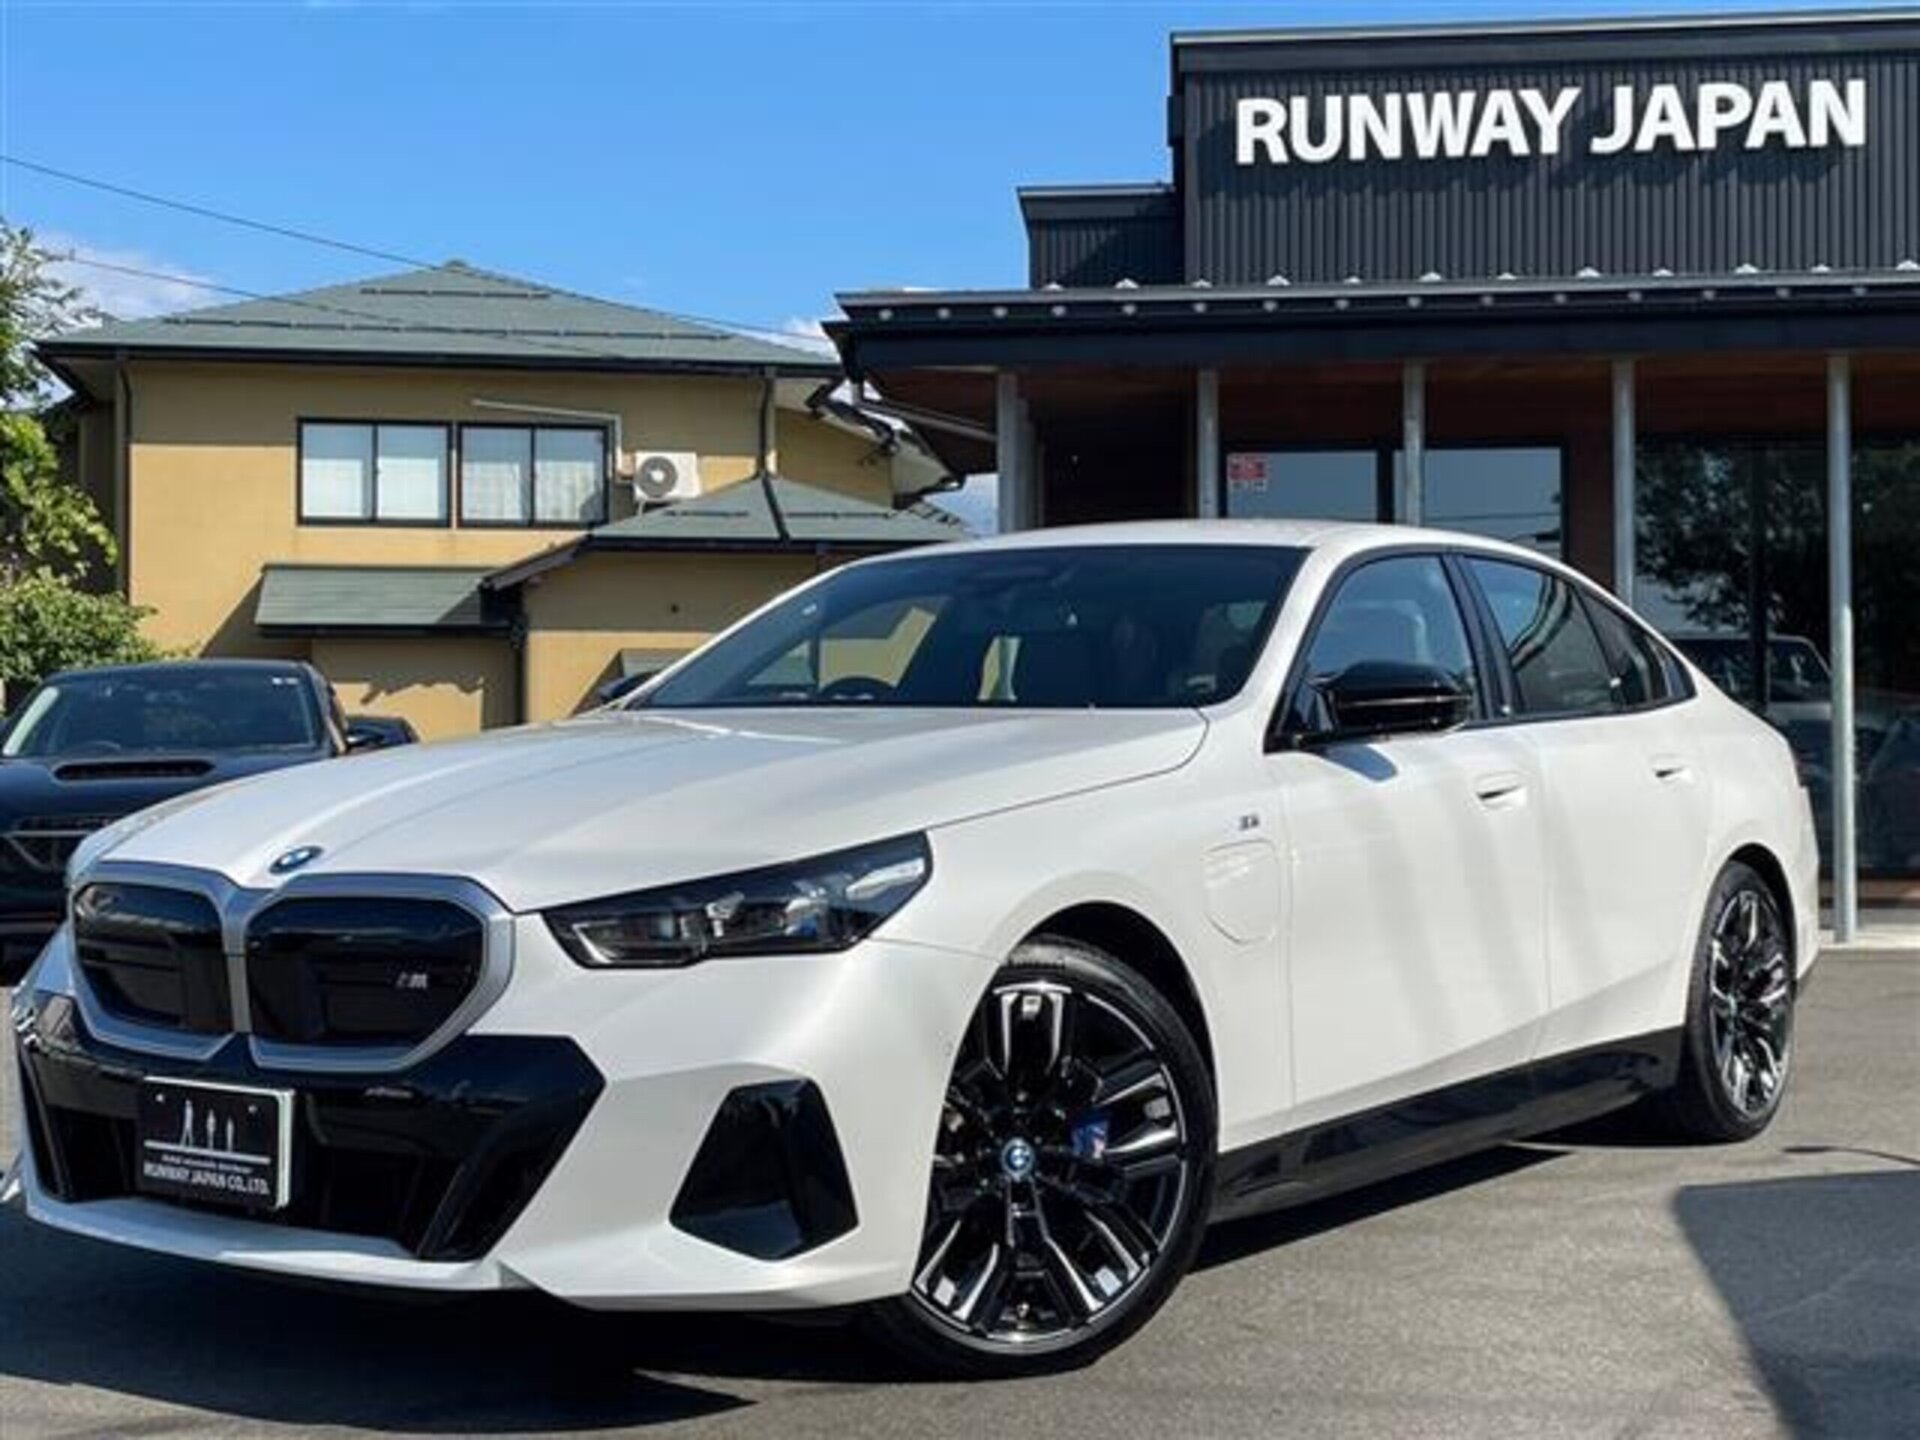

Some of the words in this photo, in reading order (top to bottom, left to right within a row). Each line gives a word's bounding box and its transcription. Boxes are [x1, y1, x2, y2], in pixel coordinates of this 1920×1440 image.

[1236, 87, 1580, 164] RUNWAY
[1590, 79, 1866, 153] JAPAN
[191, 1170, 226, 1189] JAPAN
